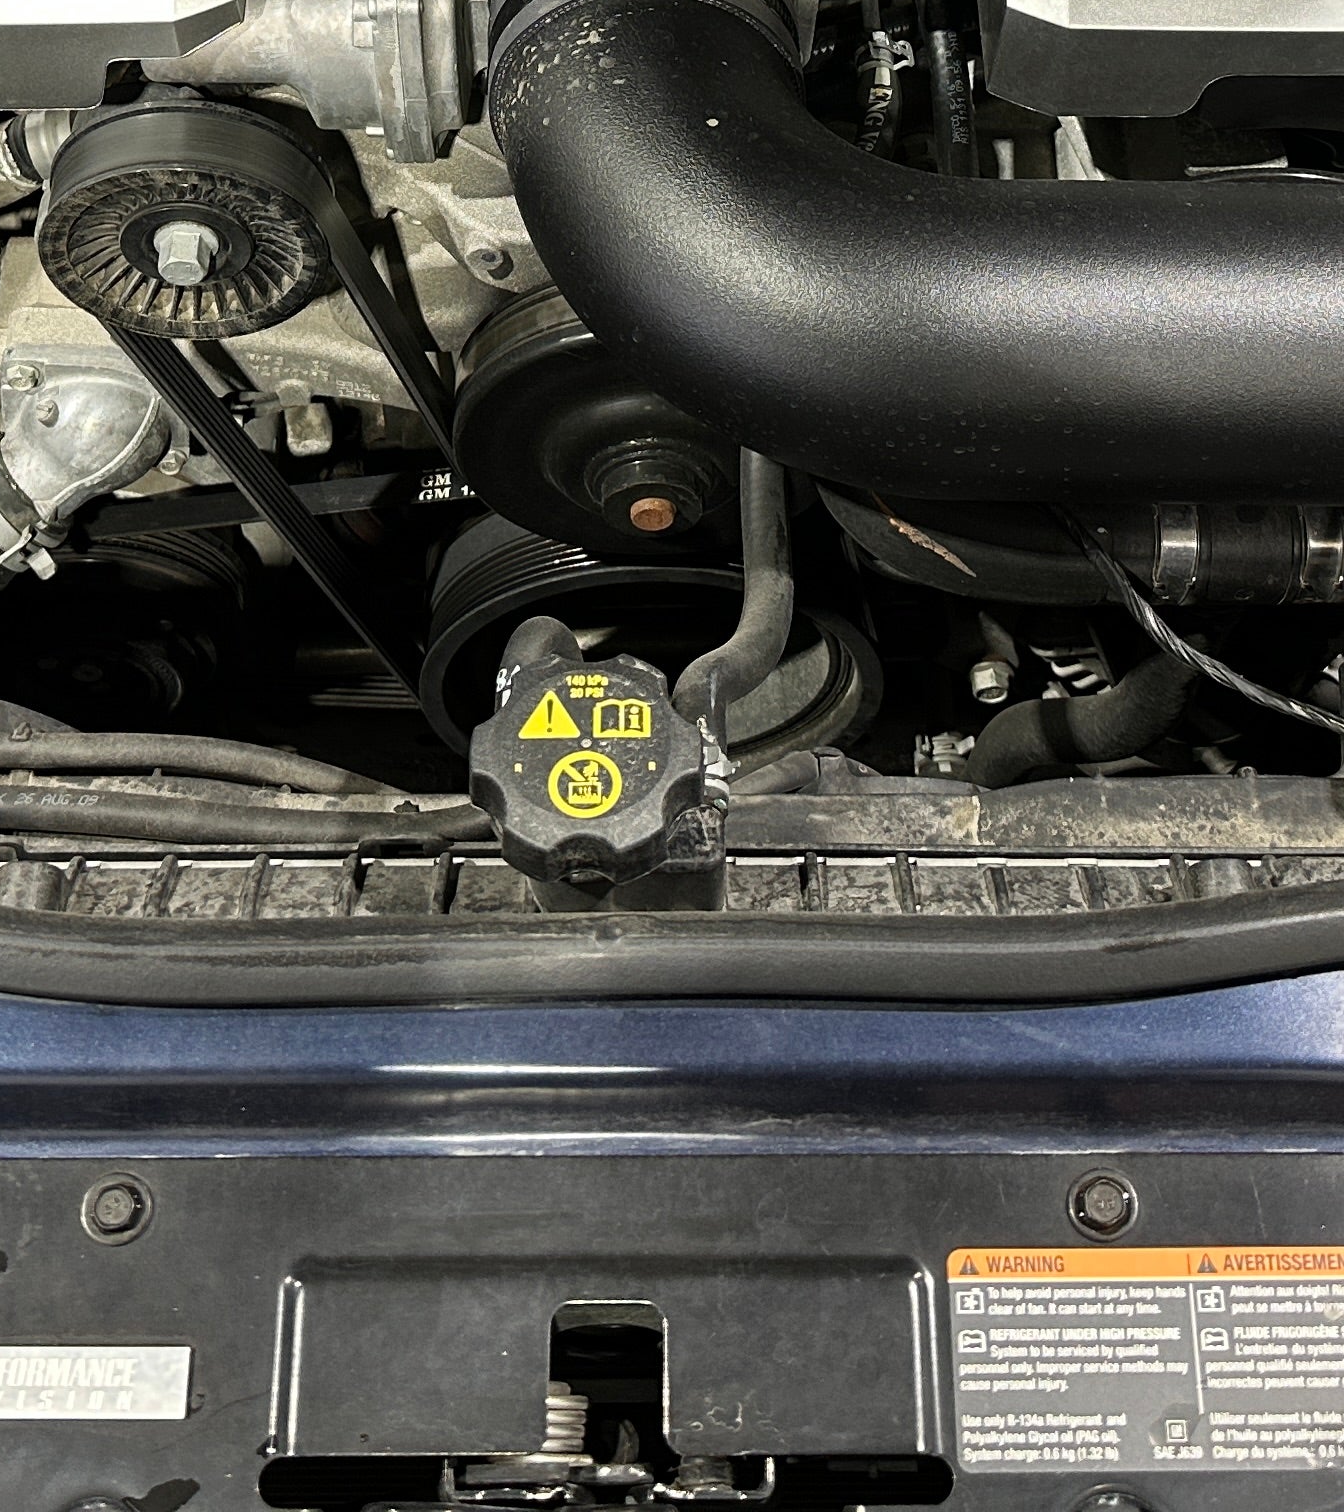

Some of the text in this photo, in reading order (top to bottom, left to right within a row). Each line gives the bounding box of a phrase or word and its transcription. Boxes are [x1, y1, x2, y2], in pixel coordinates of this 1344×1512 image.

[864, 87, 894, 127] ENG
[420, 472, 452, 488] GM
[418, 487, 452, 501] GM
[565, 675, 609, 686] 140 kPa
[585, 687, 605, 698] PSI
[13, 792, 36, 805] 26
[40, 793, 72, 806] AUG
[986, 1256, 1065, 1272] WARNING
[989, 1328, 1181, 1341] REFRIGERANT UNDER HIGH PRESSURE
[1235, 1327, 1269, 1339] FLUIDE
[1154, 1445, 1176, 1459] SAE
